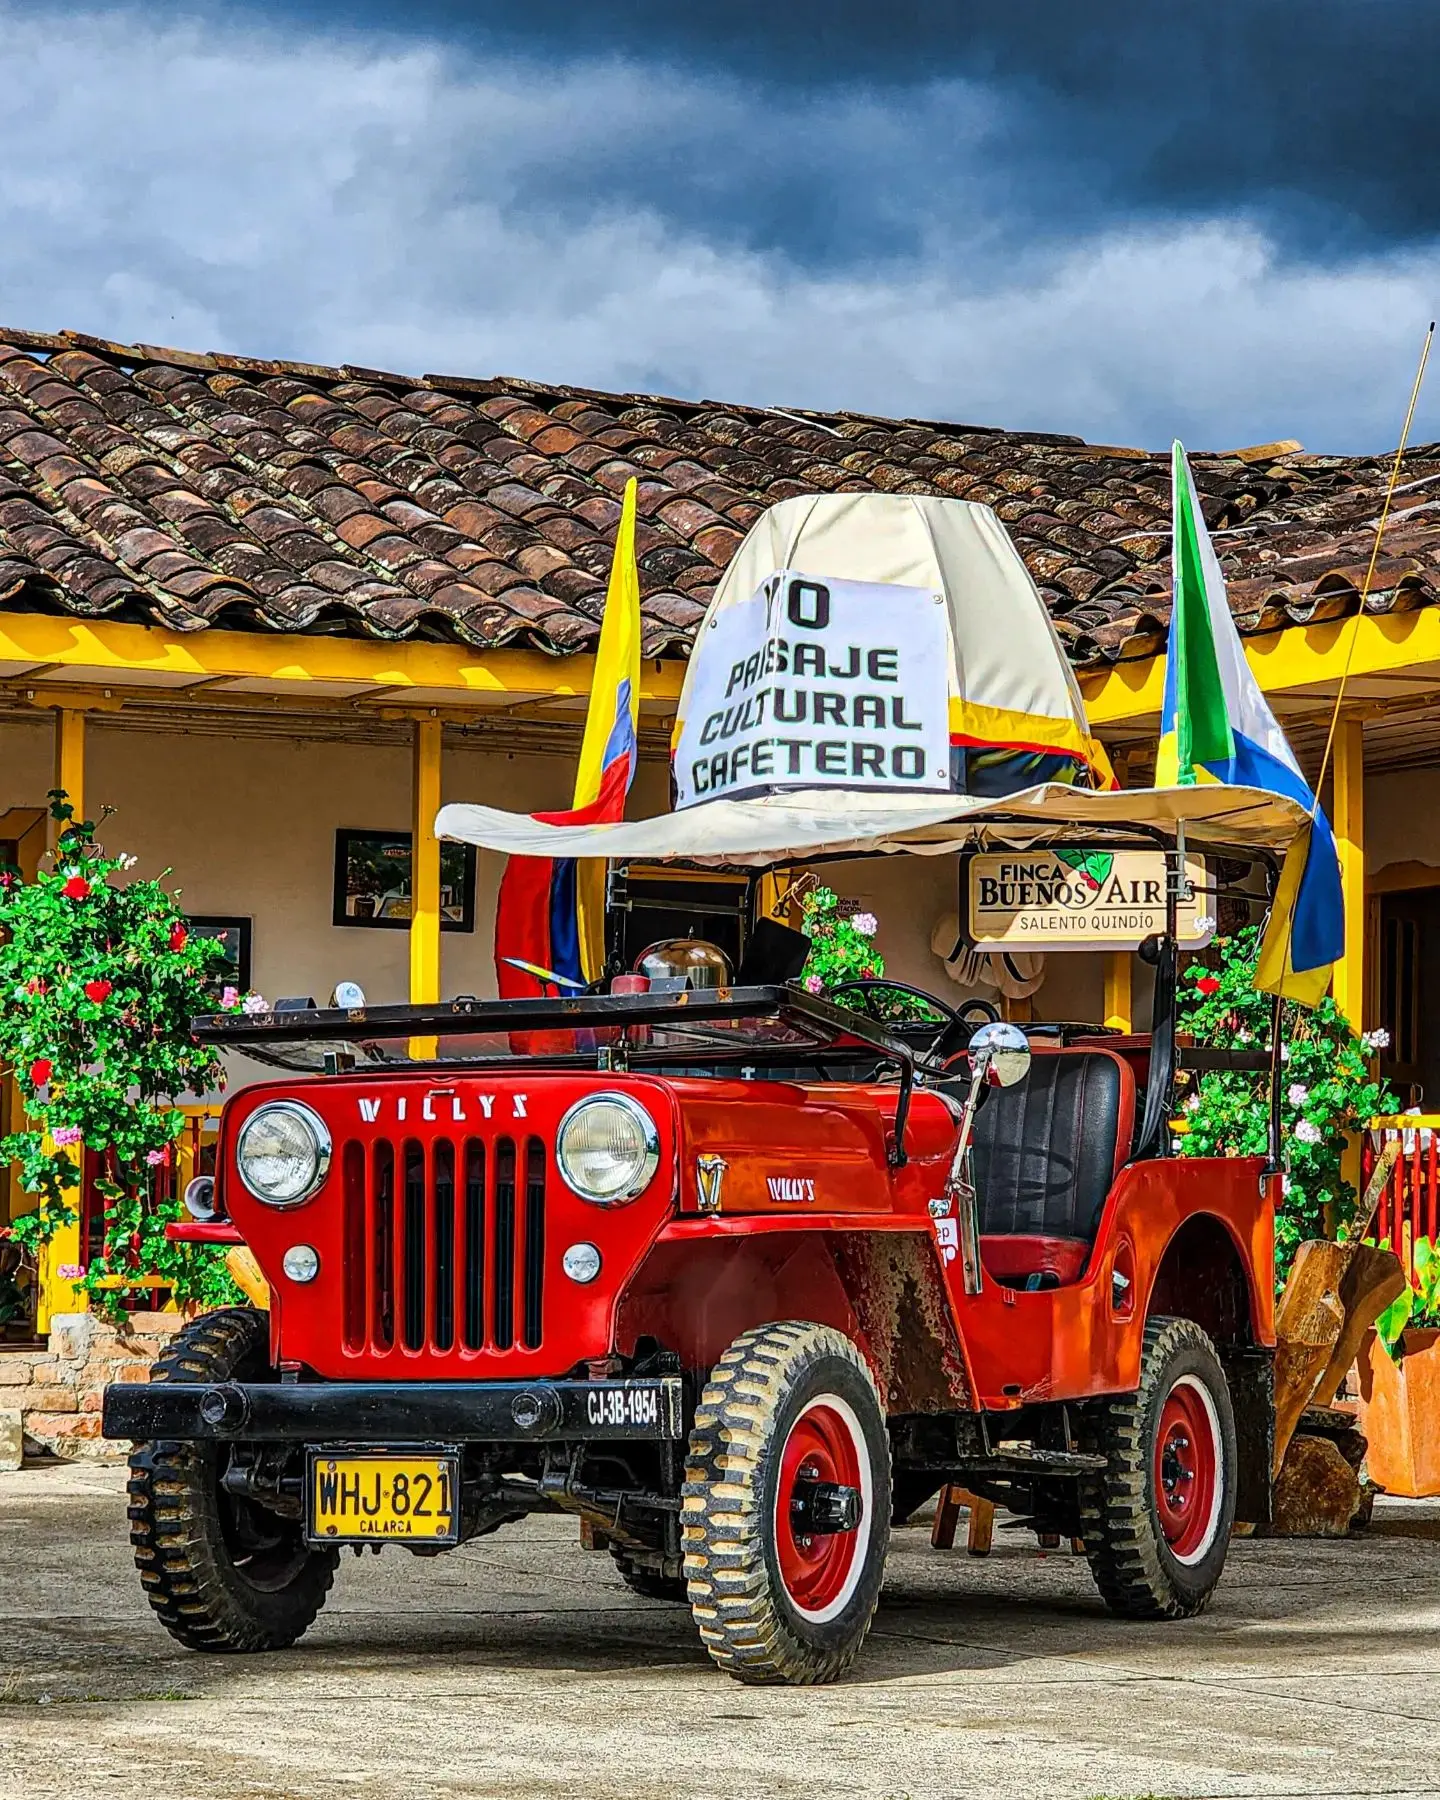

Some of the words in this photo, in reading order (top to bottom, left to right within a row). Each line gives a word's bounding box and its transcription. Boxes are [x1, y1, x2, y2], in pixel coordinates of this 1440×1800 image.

[764, 576, 830, 630] YO
[725, 638, 898, 699] PAISAJE
[700, 688, 923, 746] CULTURAL
[692, 738, 925, 796] CAFETERO
[1000, 863, 1066, 882] FINCA
[978, 877, 1087, 907] BUENOS
[1104, 873, 1197, 904] AIRS
[1020, 915, 1086, 930] SALENTO
[1091, 911, 1154, 932] QUINDÍO
[358, 1094, 528, 1123] WILLYS
[766, 1177, 815, 1201] WILLYS
[587, 1389, 658, 1425] CJ-3B-1954
[359, 1520, 412, 1534] CALARCA
